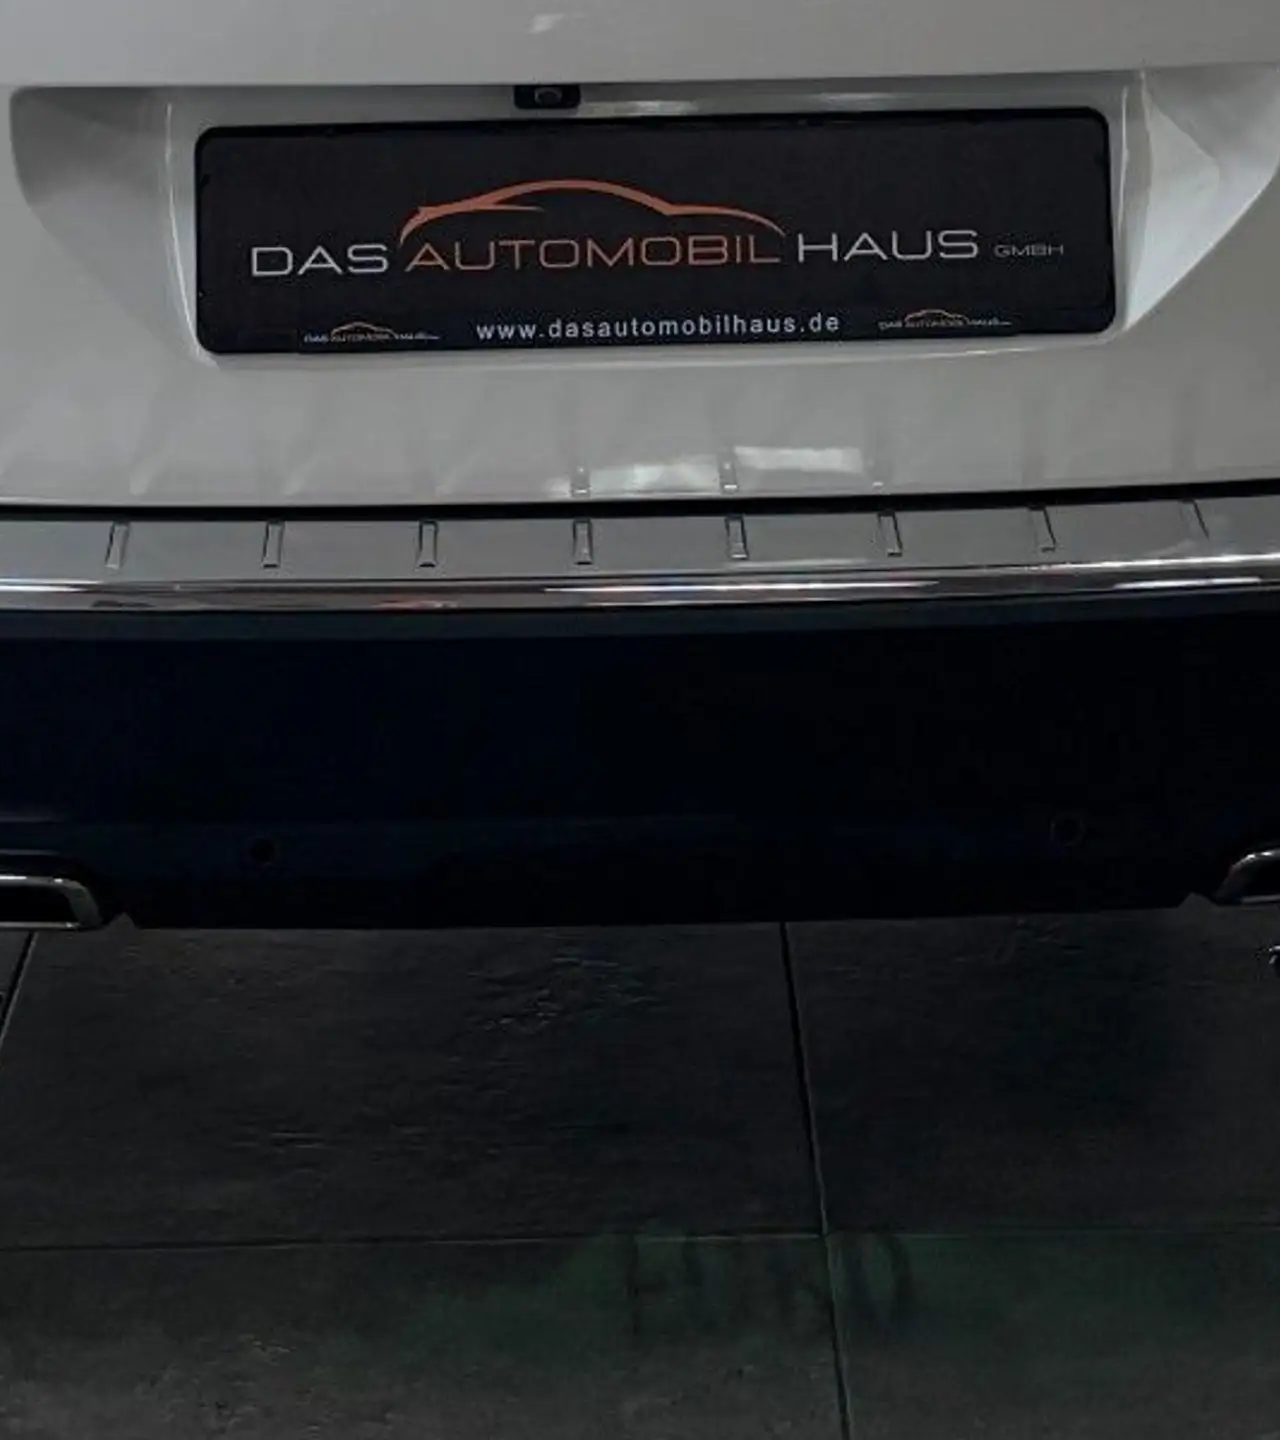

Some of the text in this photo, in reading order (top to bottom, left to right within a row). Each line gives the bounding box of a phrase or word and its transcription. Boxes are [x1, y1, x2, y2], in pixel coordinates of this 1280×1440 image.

[251, 243, 389, 276] DAS
[404, 234, 781, 272] AUTOMOBIL
[797, 229, 979, 262] HAUS
[476, 313, 839, 341] www.dasautomobilhaus.de
